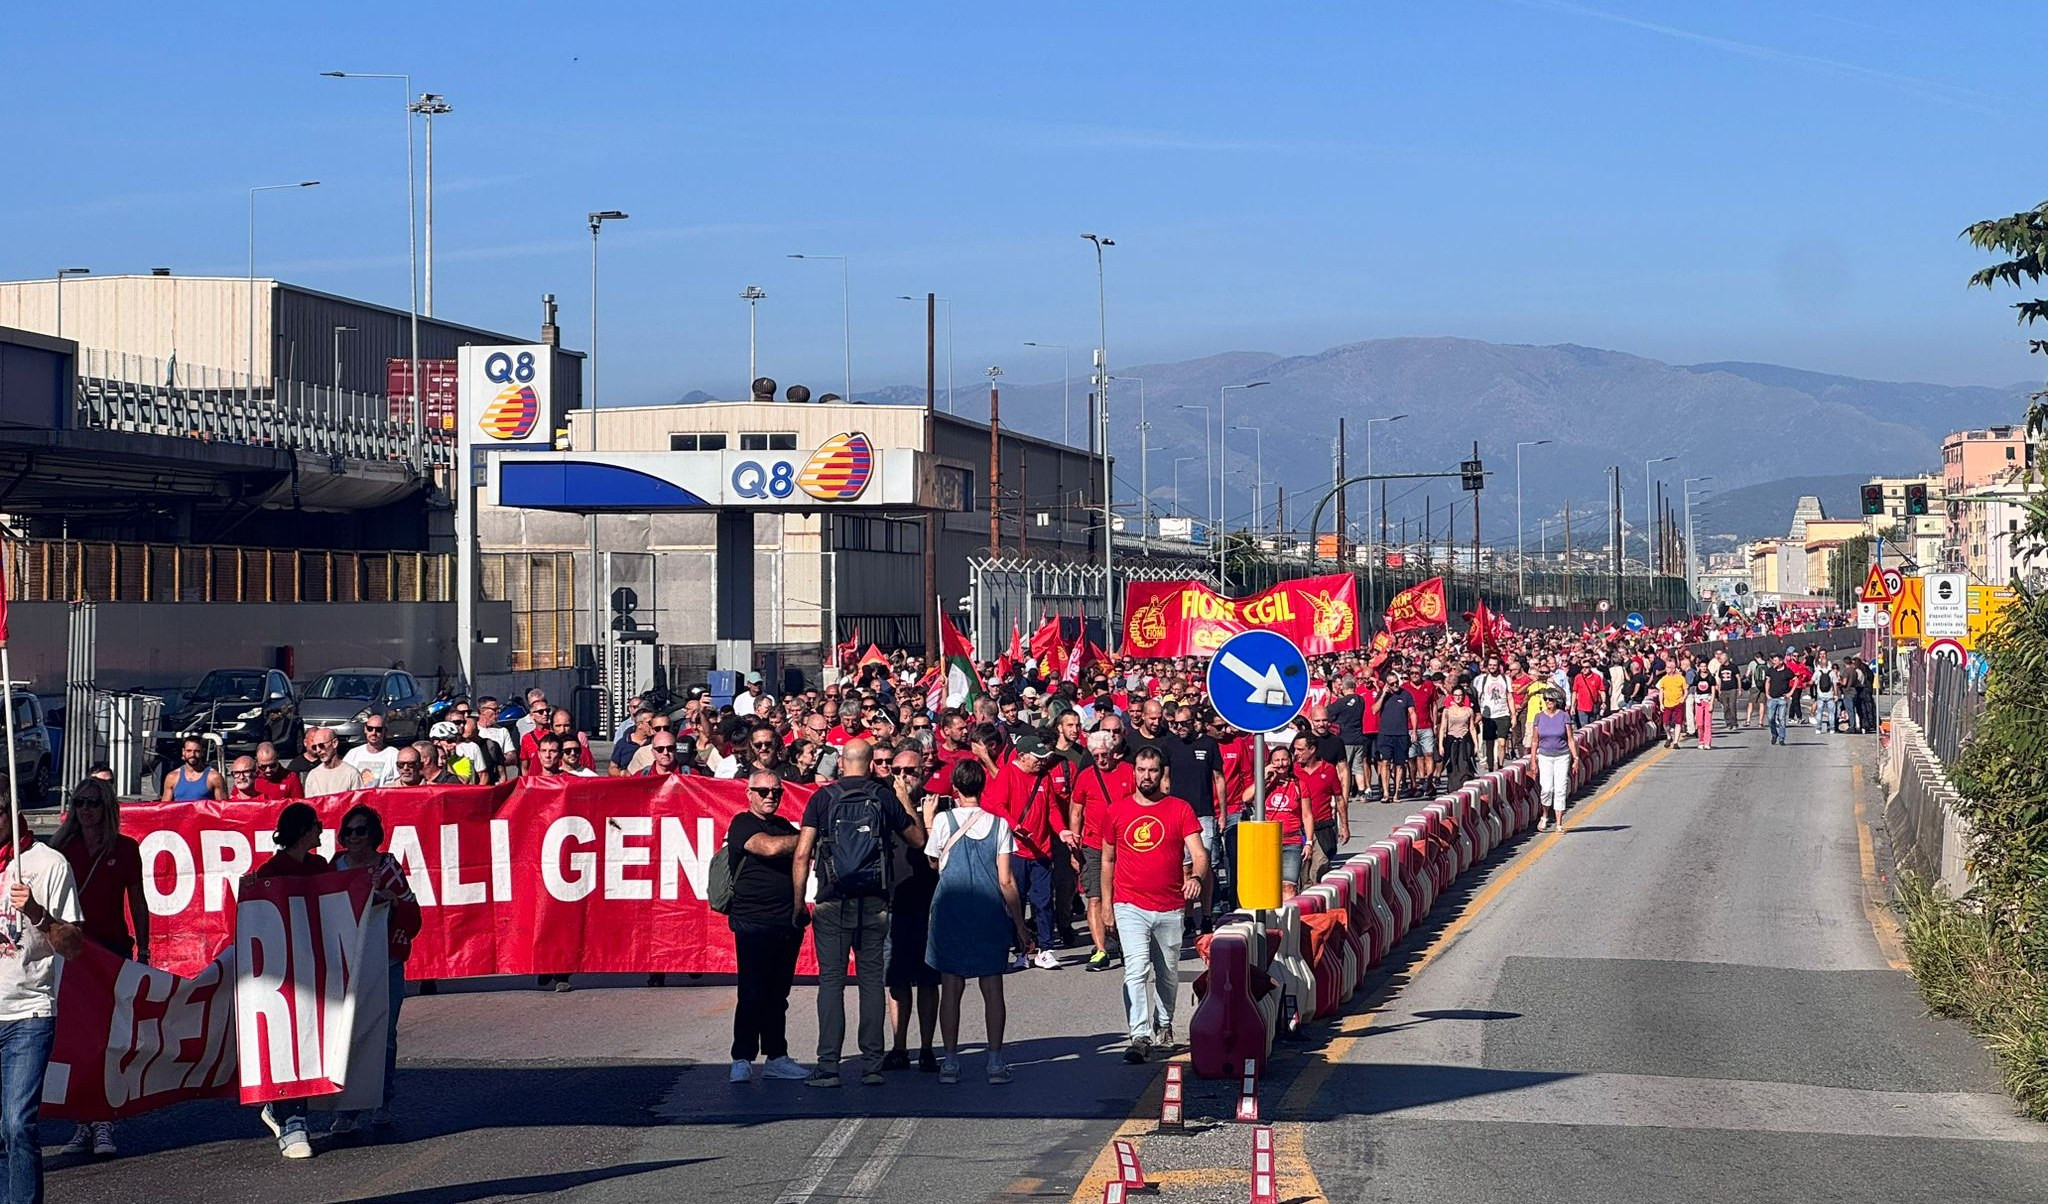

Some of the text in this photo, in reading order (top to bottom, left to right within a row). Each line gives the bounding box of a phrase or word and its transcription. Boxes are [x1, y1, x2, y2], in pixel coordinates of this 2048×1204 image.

[485, 351, 536, 384] Q8
[731, 460, 795, 500] Q8
[1243, 591, 1296, 624] CGIL
